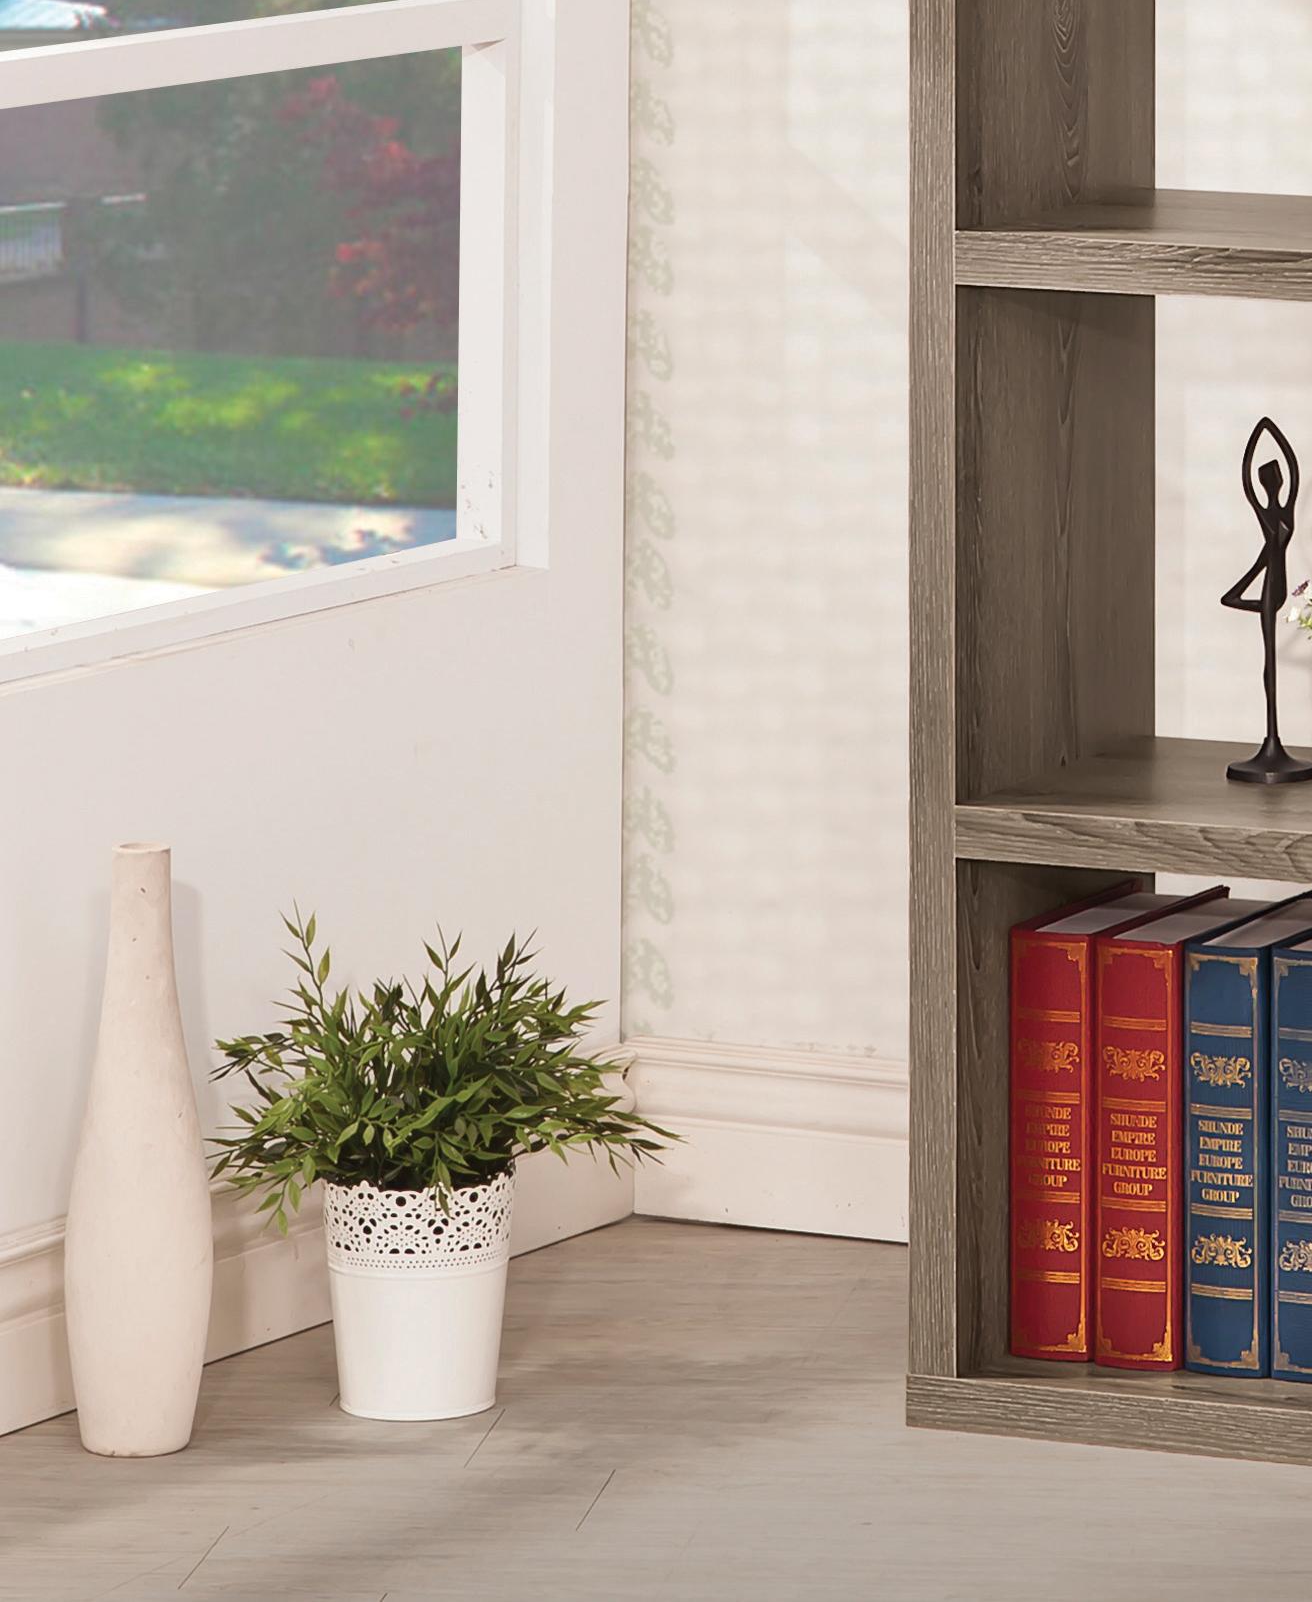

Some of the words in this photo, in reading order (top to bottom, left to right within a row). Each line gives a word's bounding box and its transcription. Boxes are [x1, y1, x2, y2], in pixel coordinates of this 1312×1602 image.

[1110, 1113, 1157, 1128] SHUNDE
[1198, 1120, 1243, 1135] SHUNDE
[1111, 1130, 1156, 1145] EMPIRE
[1199, 1136, 1242, 1152] EMPIRE
[1111, 1147, 1157, 1162] EUROPE
[1198, 1153, 1243, 1169] EUROPE
[1102, 1163, 1167, 1180] FURNITURE
[1190, 1170, 1253, 1187] FURNITURE
[1113, 1181, 1153, 1196] GROUP
[1201, 1188, 1240, 1203] GROUP
